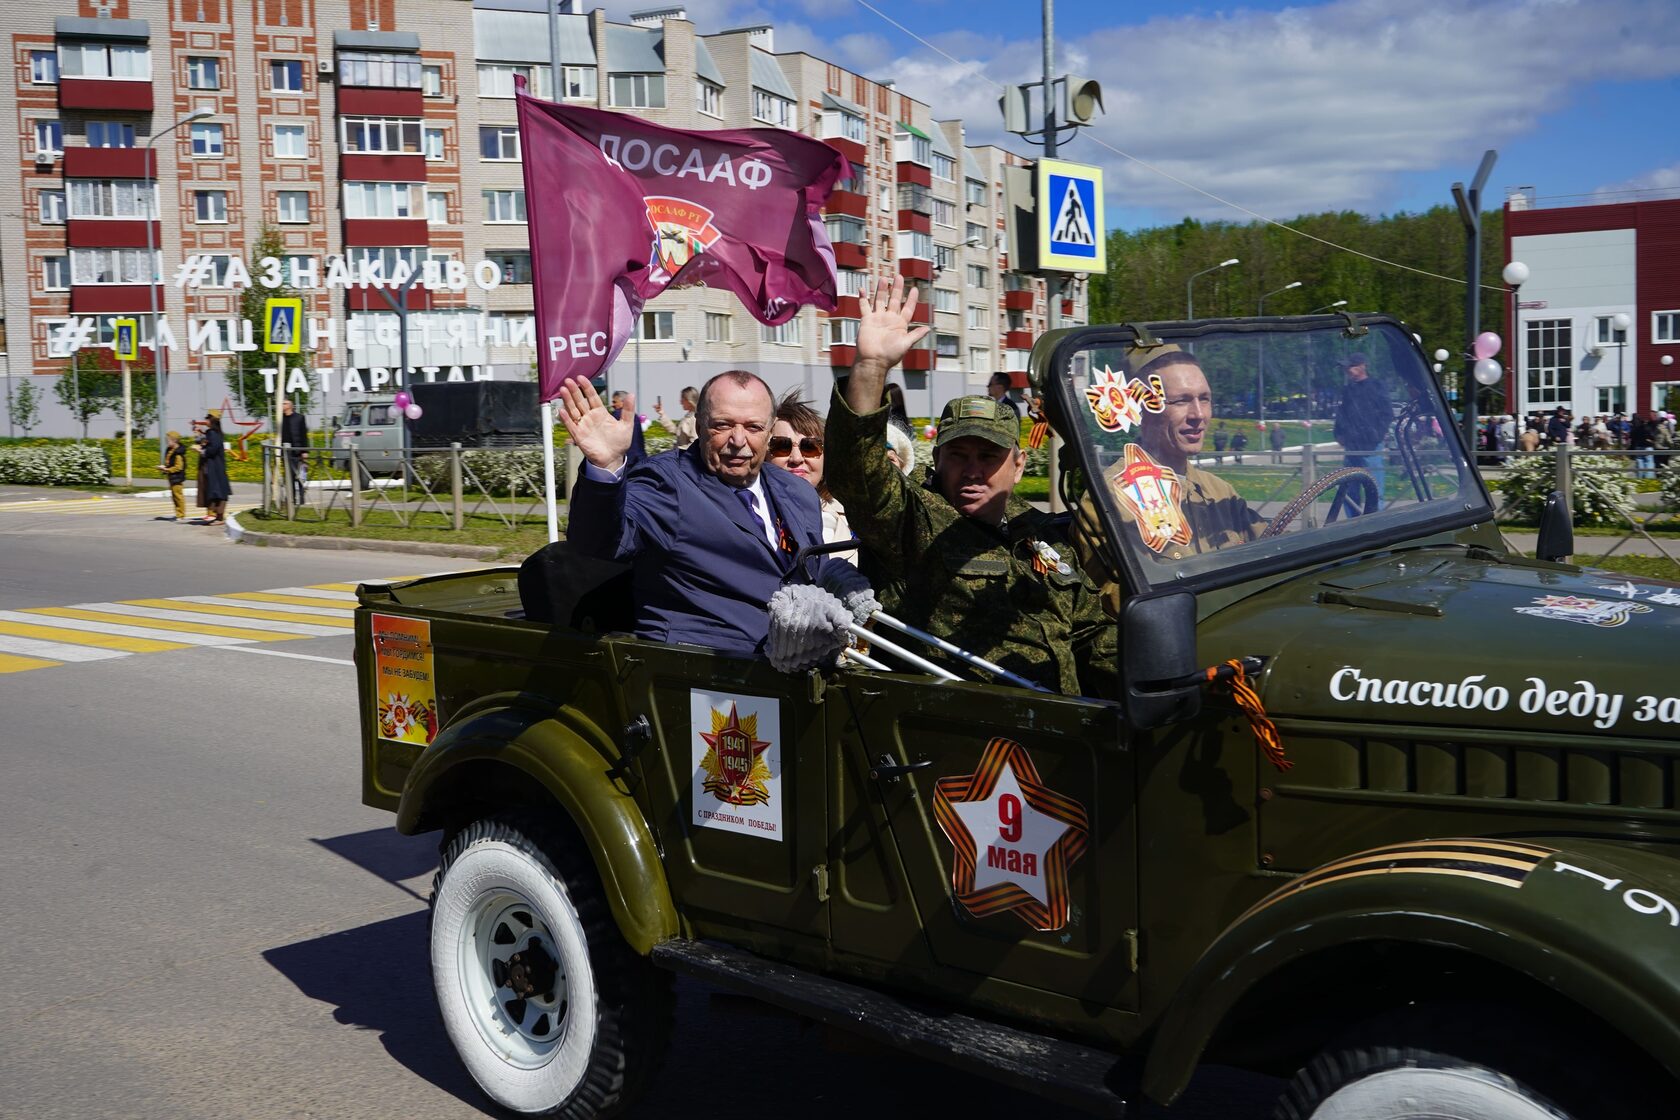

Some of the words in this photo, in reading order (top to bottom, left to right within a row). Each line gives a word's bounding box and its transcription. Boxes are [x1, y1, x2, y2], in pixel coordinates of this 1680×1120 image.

[599, 134, 773, 190] ДОСААФ
[649, 204, 687, 217] ОСААФ
[688, 211, 702, 223] РТ
[548, 331, 609, 361] РЕС
[394, 667, 402, 677] НЕ
[1329, 665, 1509, 711] Спасибо
[1520, 677, 1624, 729] деду
[1632, 695, 1680, 723] за
[722, 735, 746, 752] 1941
[722, 755, 748, 772] 1945
[697, 810, 703, 818] С
[703, 811, 745, 825] ПРАЗДНИКОМ
[748, 819, 777, 832] ПОБЕДЫ!
[998, 793, 1023, 843] 9
[987, 845, 1037, 876] мая
[1553, 861, 1680, 927] 19
